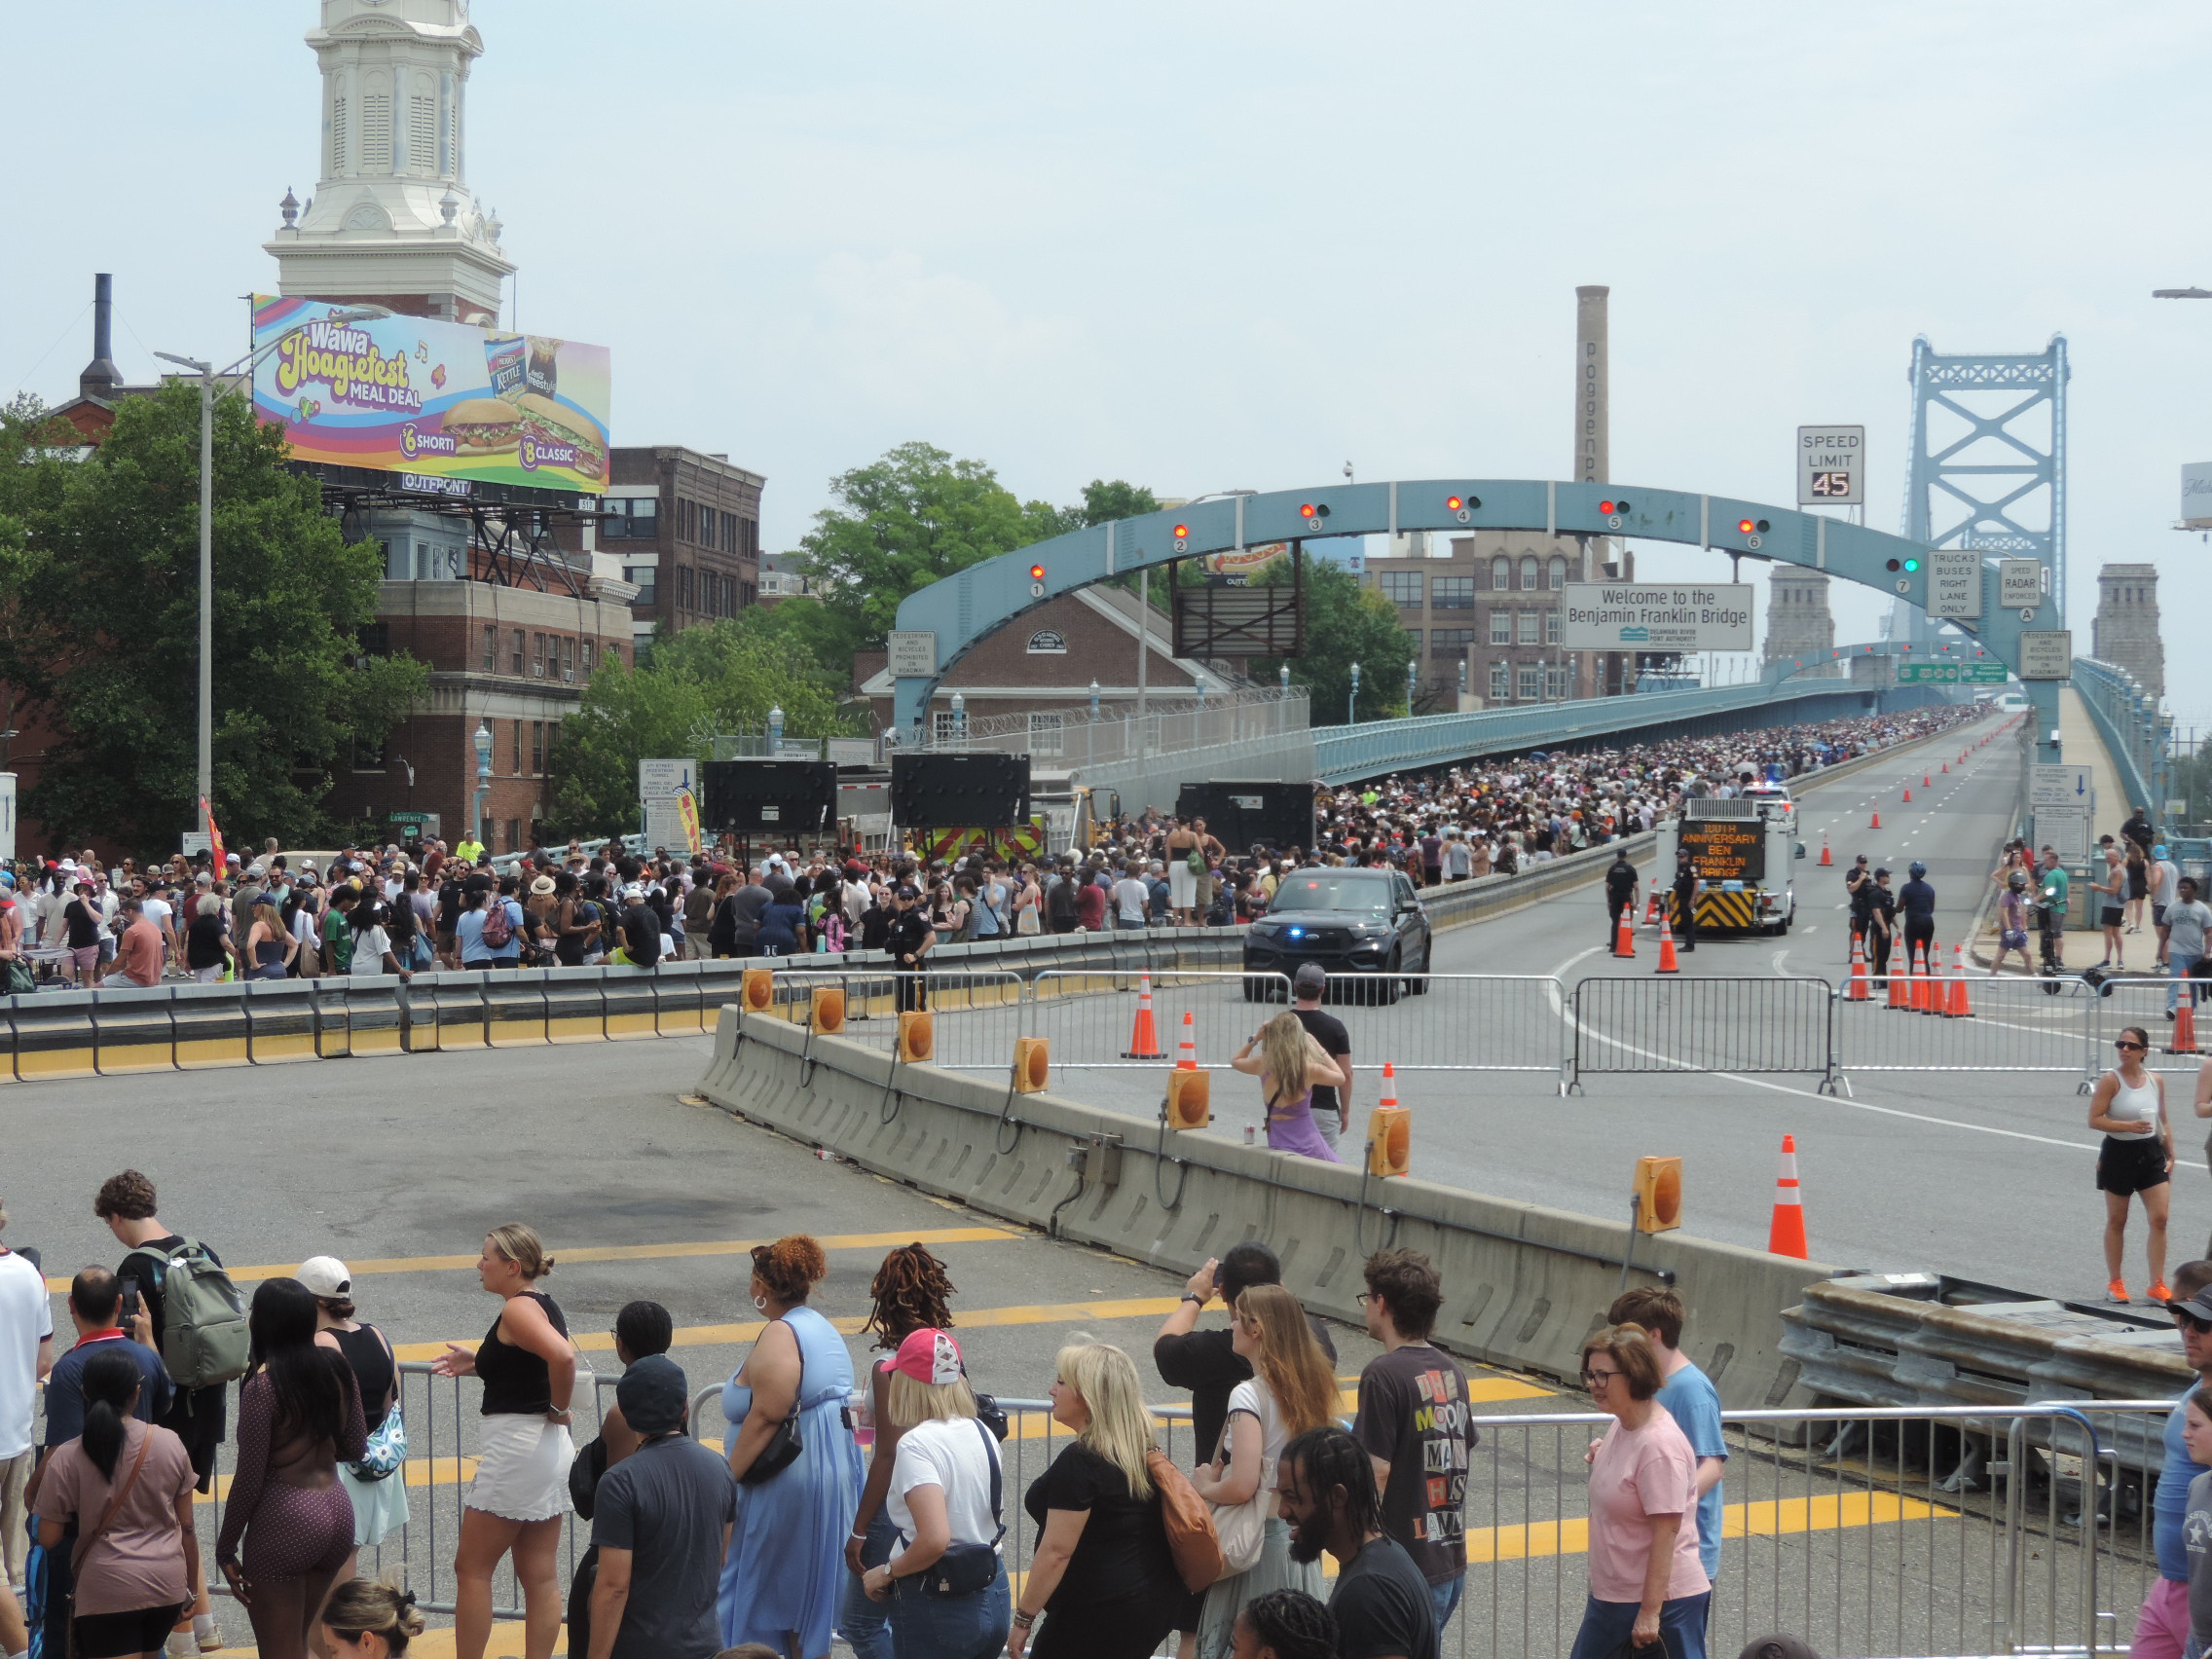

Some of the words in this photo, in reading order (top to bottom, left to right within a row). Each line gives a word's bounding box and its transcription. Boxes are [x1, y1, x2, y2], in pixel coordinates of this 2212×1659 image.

[311, 322, 368, 355] Wawa
[278, 332, 409, 396] Hoagiefest
[497, 365, 521, 390] KETTLE
[528, 373, 557, 393] freestyle
[350, 383, 386, 403] MEAL
[388, 388, 422, 408] DEAL
[417, 434, 455, 452] SHORTI
[1803, 435, 1860, 449] SPEED
[535, 447, 573, 462] CLASSIC
[1808, 455, 1854, 467] LIMIT
[405, 476, 468, 494] OUTFRONT
[1813, 473, 1849, 496] 45
[582, 499, 593, 510] 513
[1458, 511, 1466, 521] 4
[1611, 517, 1619, 528] 5
[1311, 519, 1319, 530] 3
[1176, 541, 1184, 551] 2
[1750, 536, 1758, 547] 6
[1934, 554, 1975, 563] TRUCKS
[1899, 581, 1907, 591] 7
[1939, 580, 1968, 589] RIGHT
[2006, 579, 2037, 589] RADAR
[1602, 589, 1668, 605] Welcome
[1674, 590, 1687, 605] to
[1692, 589, 1715, 605] the
[1568, 608, 1636, 626] Benjamin
[1641, 608, 1697, 624] Franklin
[1701, 608, 1748, 628] Bridge
[1682, 834, 1756, 843] ANNIVERSARY
[1708, 845, 1732, 855] BEN
[1693, 857, 1746, 866] FRANKLIN
[1416, 1371, 1457, 1402] THE
[1424, 1439, 1466, 1472] MAN
